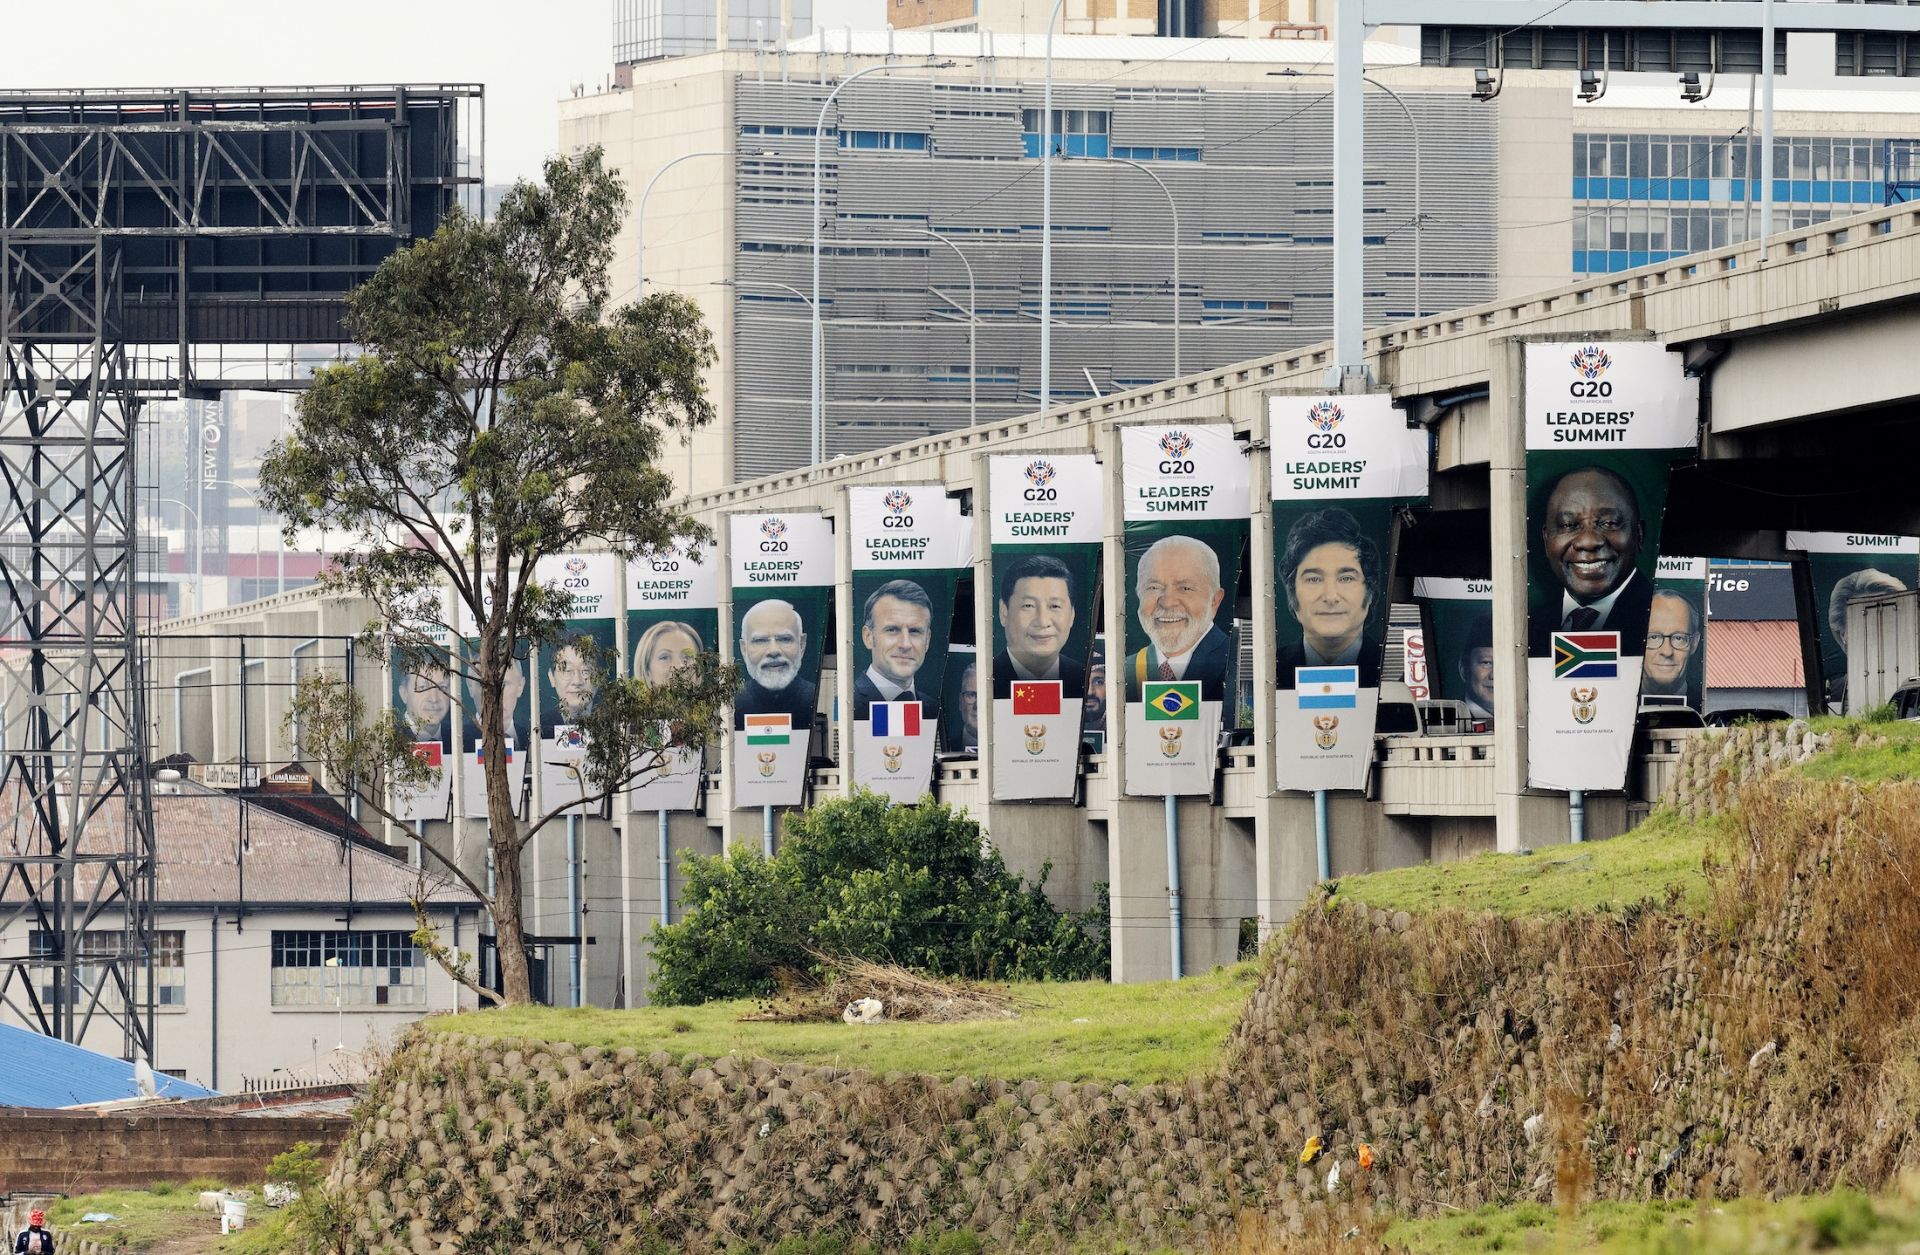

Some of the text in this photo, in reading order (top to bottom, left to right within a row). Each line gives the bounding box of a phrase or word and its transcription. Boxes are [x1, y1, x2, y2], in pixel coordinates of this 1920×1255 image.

[1570, 381, 1612, 397] G20
[1546, 411, 1634, 425] LEADERS'
[1307, 433, 1346, 449] G20
[1553, 429, 1626, 442] SUMMIT
[1159, 460, 1195, 474] G20
[1286, 460, 1367, 474] LEADERS'
[1293, 477, 1360, 490] SUMMIT
[1024, 488, 1057, 501] G20
[1139, 485, 1214, 498] LEADERS'
[1146, 500, 1208, 512] SUMMIT
[883, 516, 914, 528] G20
[1005, 511, 1075, 523] LEADERS'
[1011, 525, 1069, 536] SUMMIT
[866, 537, 930, 548] LEADERS'
[1846, 535, 1902, 546] SUMMIT
[760, 541, 789, 552] G20
[871, 550, 925, 560] SUMMIT
[652, 561, 679, 572] G20
[744, 560, 803, 571] LEADERS'
[1657, 560, 1693, 571] MMIT
[564, 577, 589, 588] G20
[749, 572, 798, 582] SUMMIT
[637, 579, 693, 590] LEADERS'
[642, 591, 689, 600] SUMMIT
